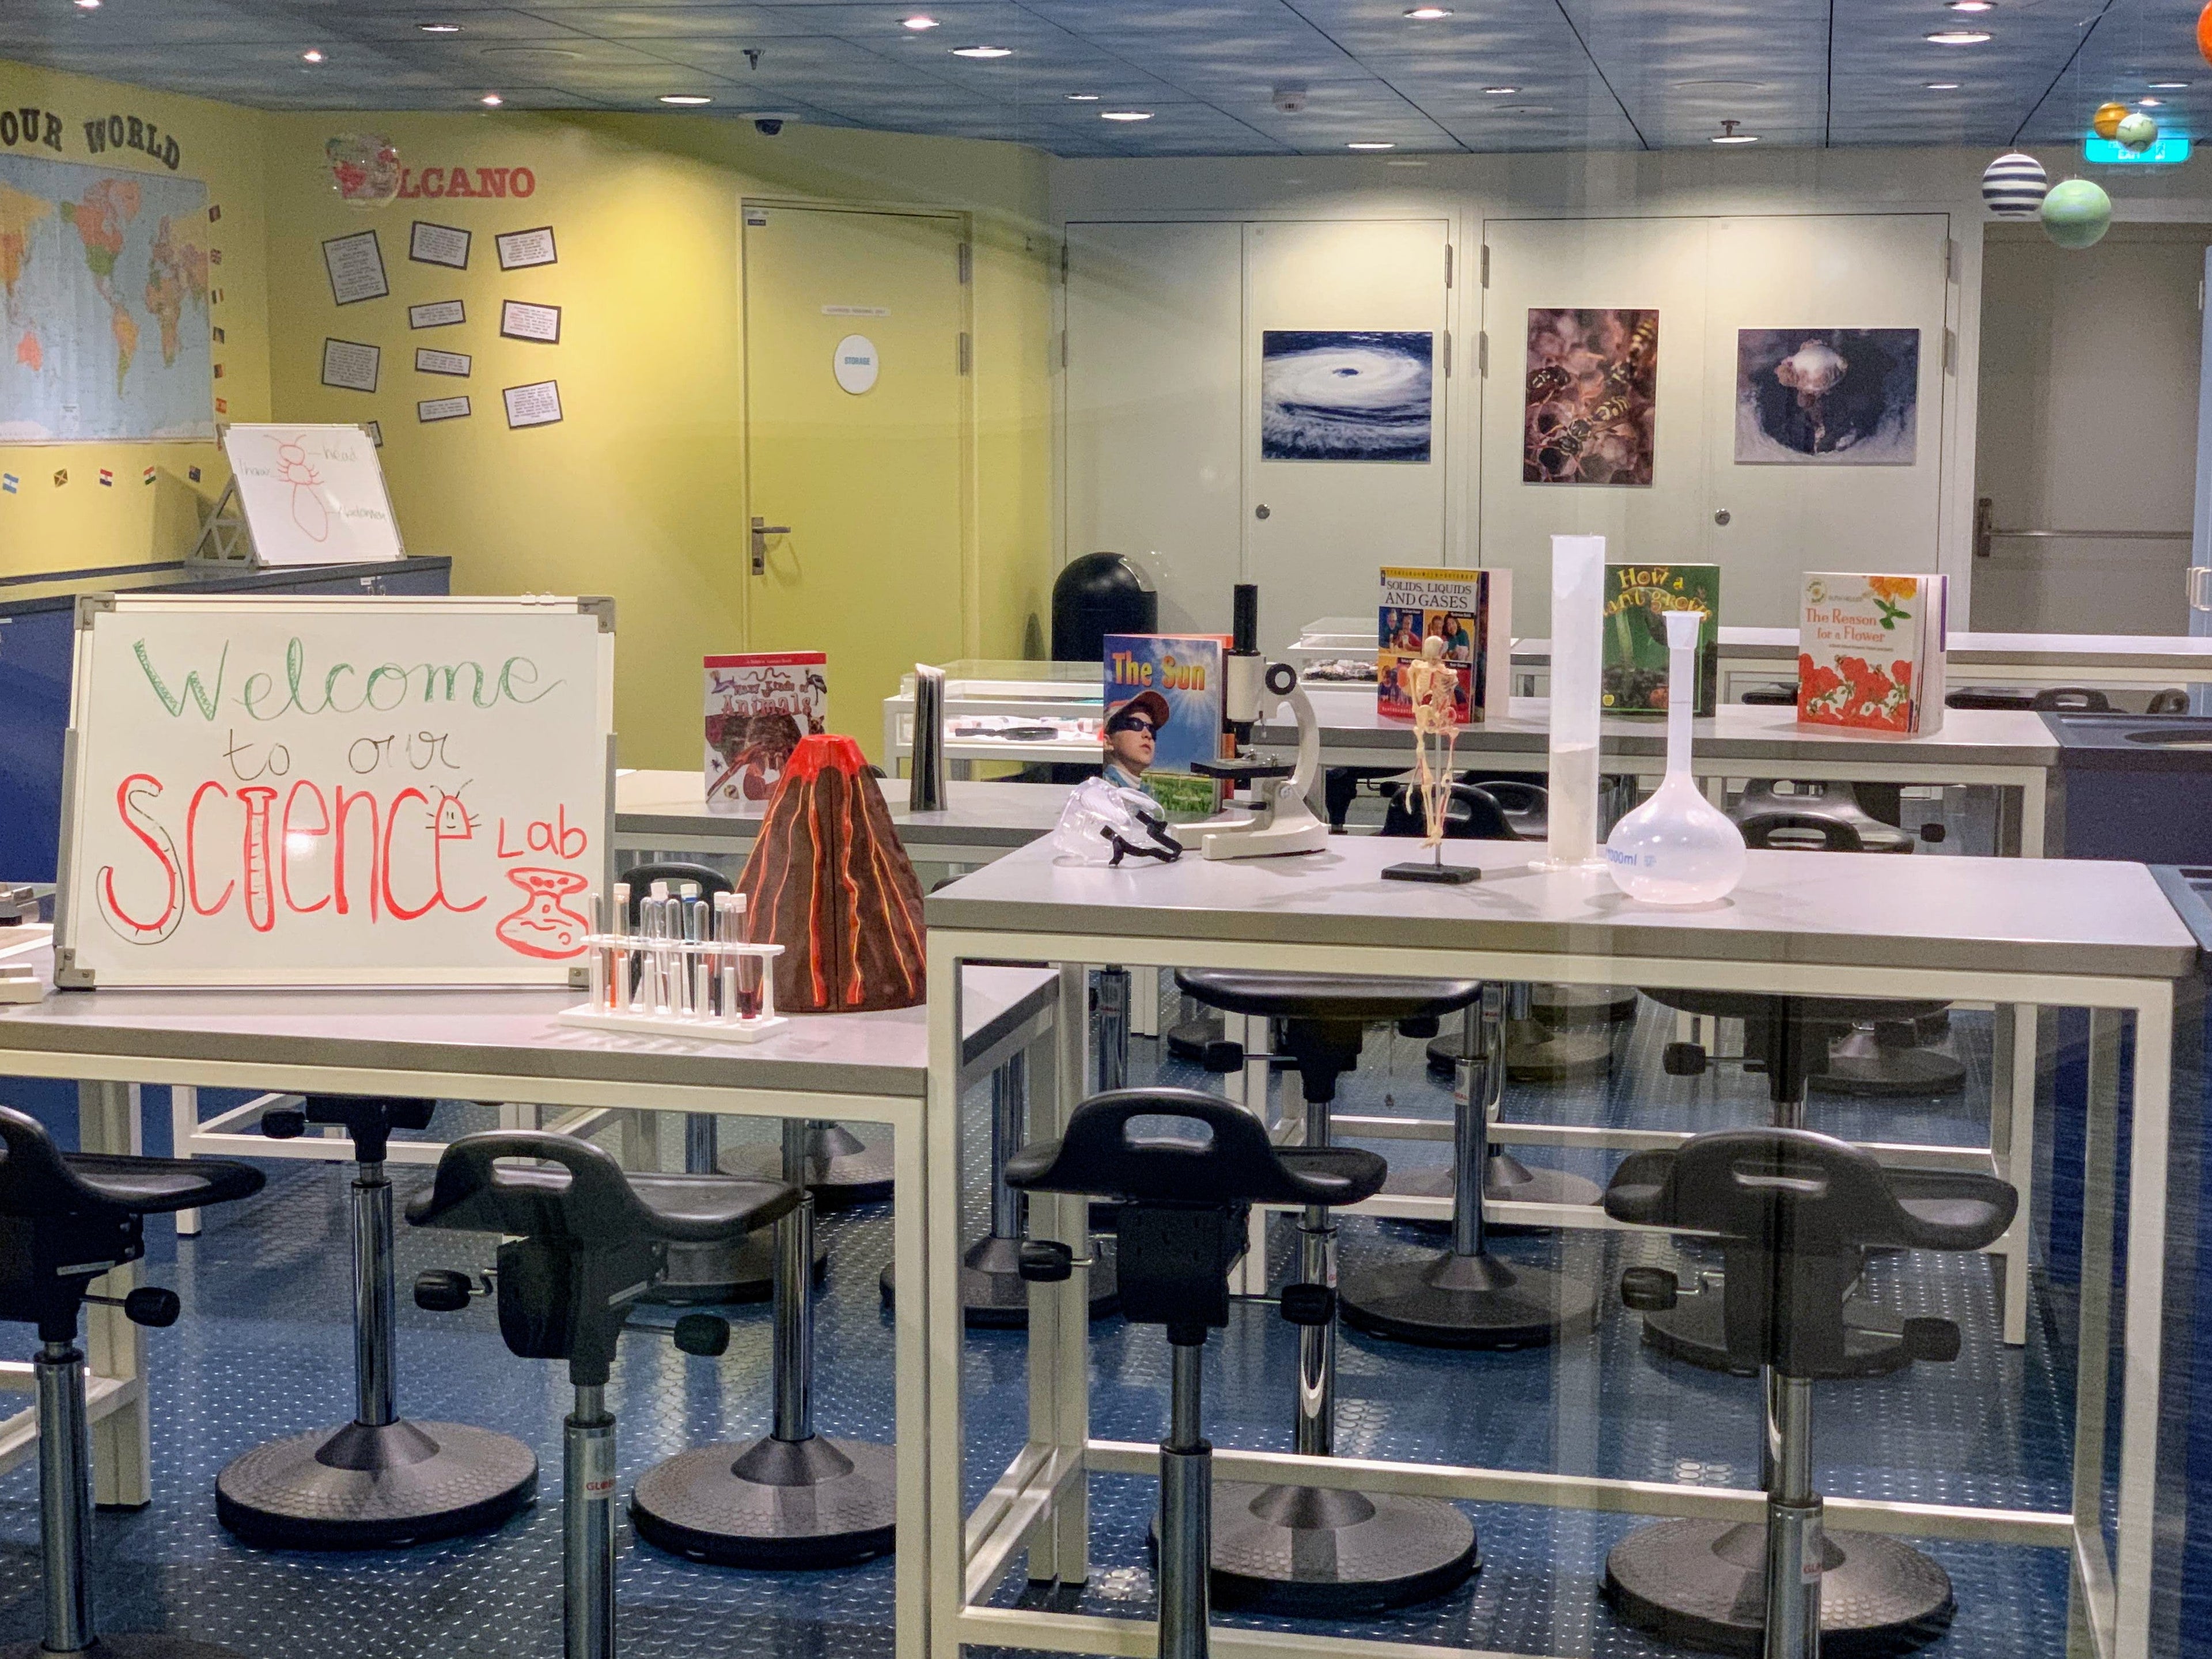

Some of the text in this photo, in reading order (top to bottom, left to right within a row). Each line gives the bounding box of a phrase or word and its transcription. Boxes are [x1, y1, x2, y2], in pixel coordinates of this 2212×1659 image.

[0, 108, 180, 170] OUR WORLD
[342, 166, 536, 199] LCANO
[844, 357, 870, 365] STORAGE
[323, 445, 357, 462] head
[1387, 581, 1472, 595] SOLIDS, LIQUIDS
[1618, 567, 1684, 590] How a
[1385, 592, 1468, 609] AND GASES
[1806, 608, 1877, 626] The Reason
[1817, 627, 1832, 639] for
[1844, 625, 1886, 642] Flower
[133, 637, 567, 721] Welcome
[1112, 650, 1206, 691] The Sun
[721, 693, 812, 719] Animals
[223, 729, 460, 781] to our
[497, 802, 587, 859] Lab
